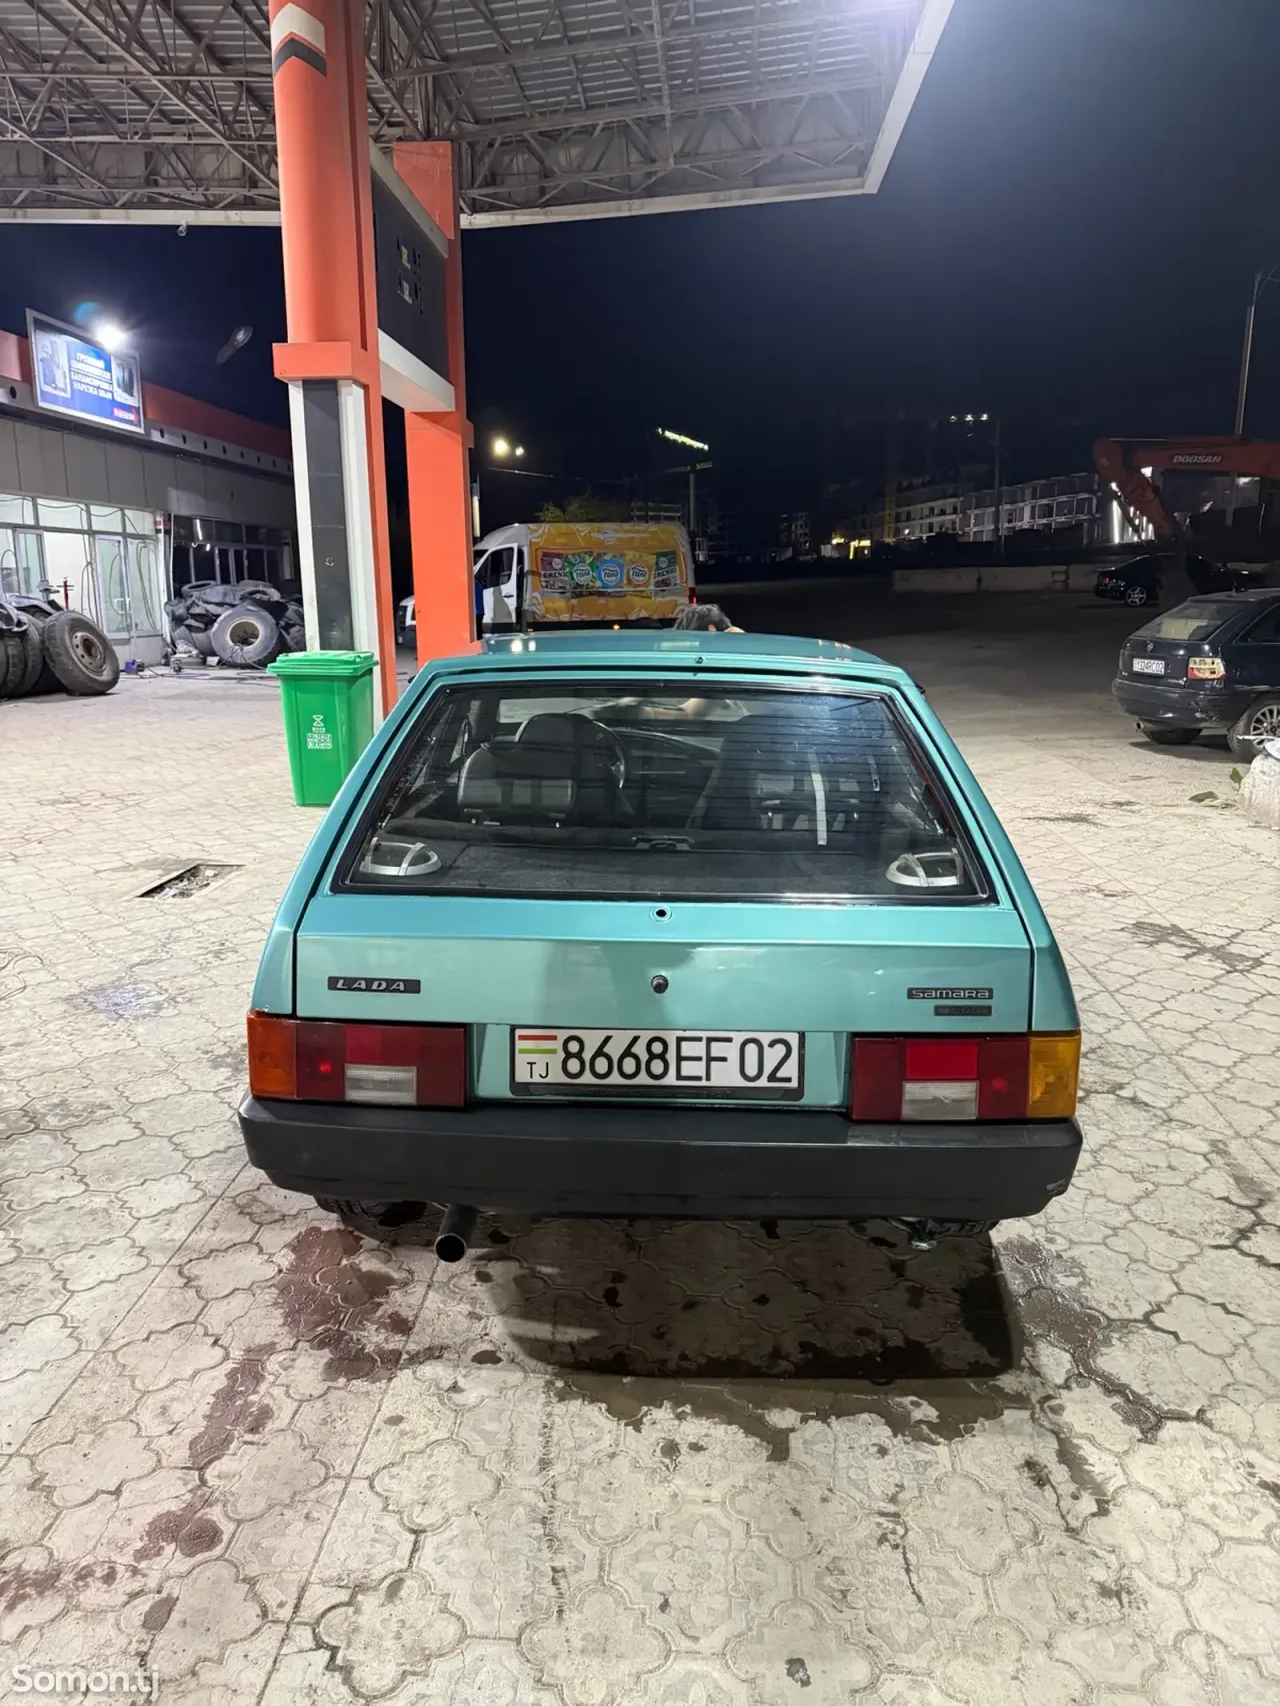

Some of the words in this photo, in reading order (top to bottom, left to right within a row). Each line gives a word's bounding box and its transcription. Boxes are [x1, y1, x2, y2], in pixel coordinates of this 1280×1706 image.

[1172, 455, 1222, 463] DOOSAN
[336, 979, 405, 991] LADA
[526, 1061, 549, 1079] TJ
